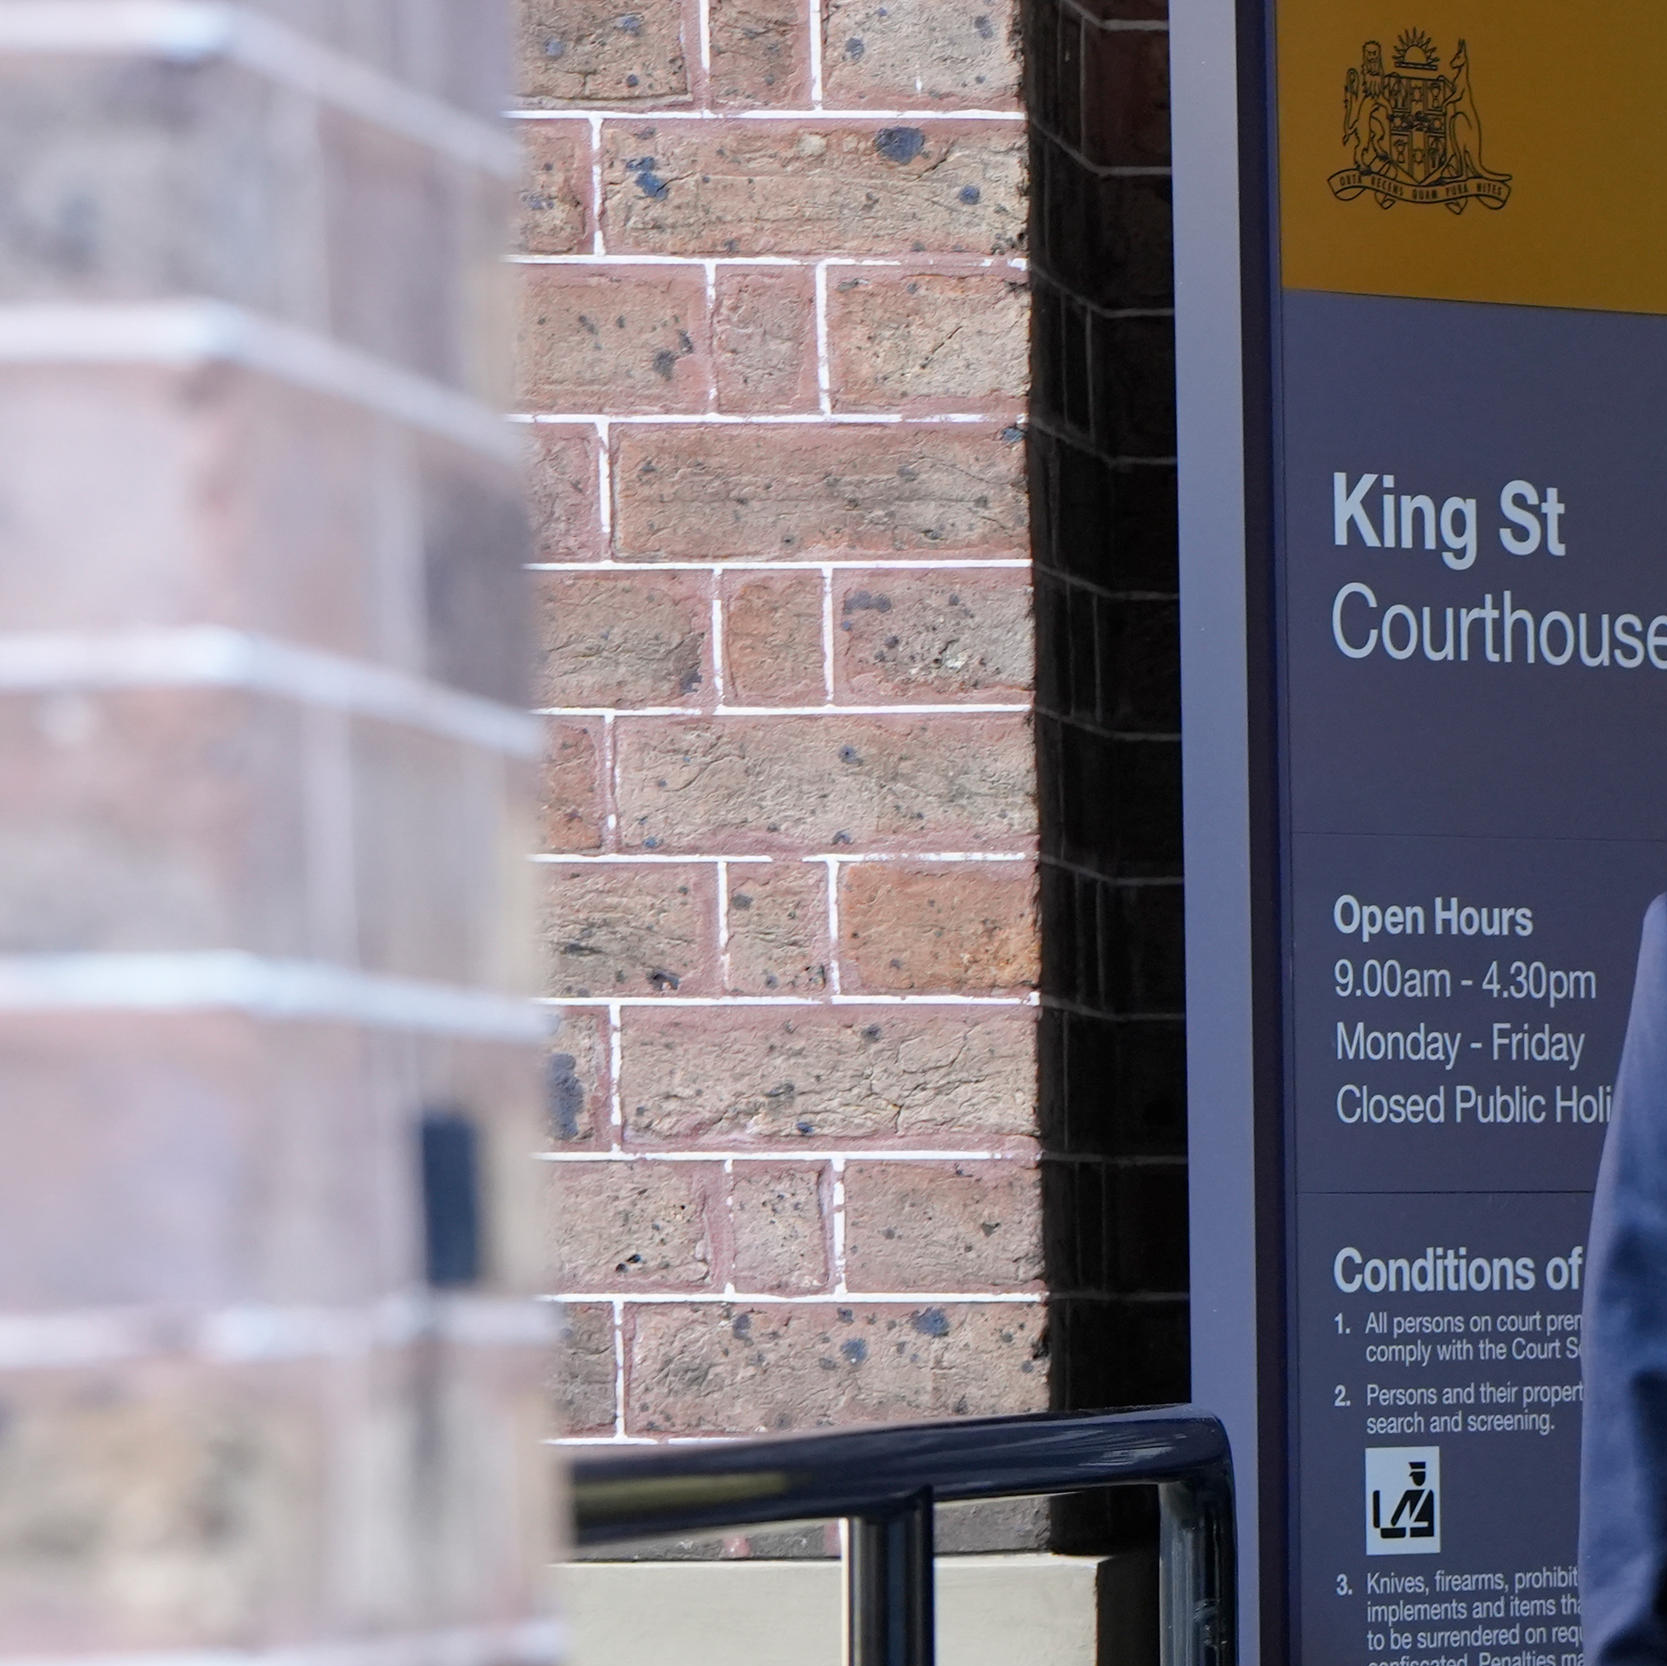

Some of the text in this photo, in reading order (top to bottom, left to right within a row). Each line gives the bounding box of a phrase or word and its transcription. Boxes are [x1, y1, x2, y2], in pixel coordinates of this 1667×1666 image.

[1333, 472, 1566, 570] King St
[1334, 895, 1533, 942] Open Hours
[1335, 959, 1451, 998] 9.00am
[1482, 961, 1597, 1008] 4.30pm
[1337, 1022, 1461, 1070] Monday
[1493, 1023, 1585, 1070] Friday
[1336, 1084, 1611, 1123] Closed Public Holi
[1334, 1246, 1583, 1293] Conditions of
[1334, 1313, 1350, 1334] 1.
[1366, 1312, 1387, 1334] All
[1394, 1313, 1464, 1338] persons
[1470, 1314, 1491, 1332] on
[1497, 1311, 1541, 1332] court
[1366, 1339, 1431, 1367] comply
[1437, 1338, 1473, 1361] with
[1479, 1338, 1506, 1360] the
[1512, 1337, 1560, 1359] Court
[1334, 1381, 1584, 1407] 2. Persons and their propert
[1367, 1409, 1554, 1436] search and screening.
[1336, 1566, 1578, 1597] 3. Knives, firearms, prohibit
[1367, 1601, 1467, 1626] implements
[1473, 1597, 1505, 1619] and
[1510, 1597, 1556, 1617] items
[1367, 1630, 1384, 1650] to
[1390, 1628, 1412, 1649] be
[1417, 1624, 1520, 1647] surrendered
[1525, 1628, 1546, 1645] on
